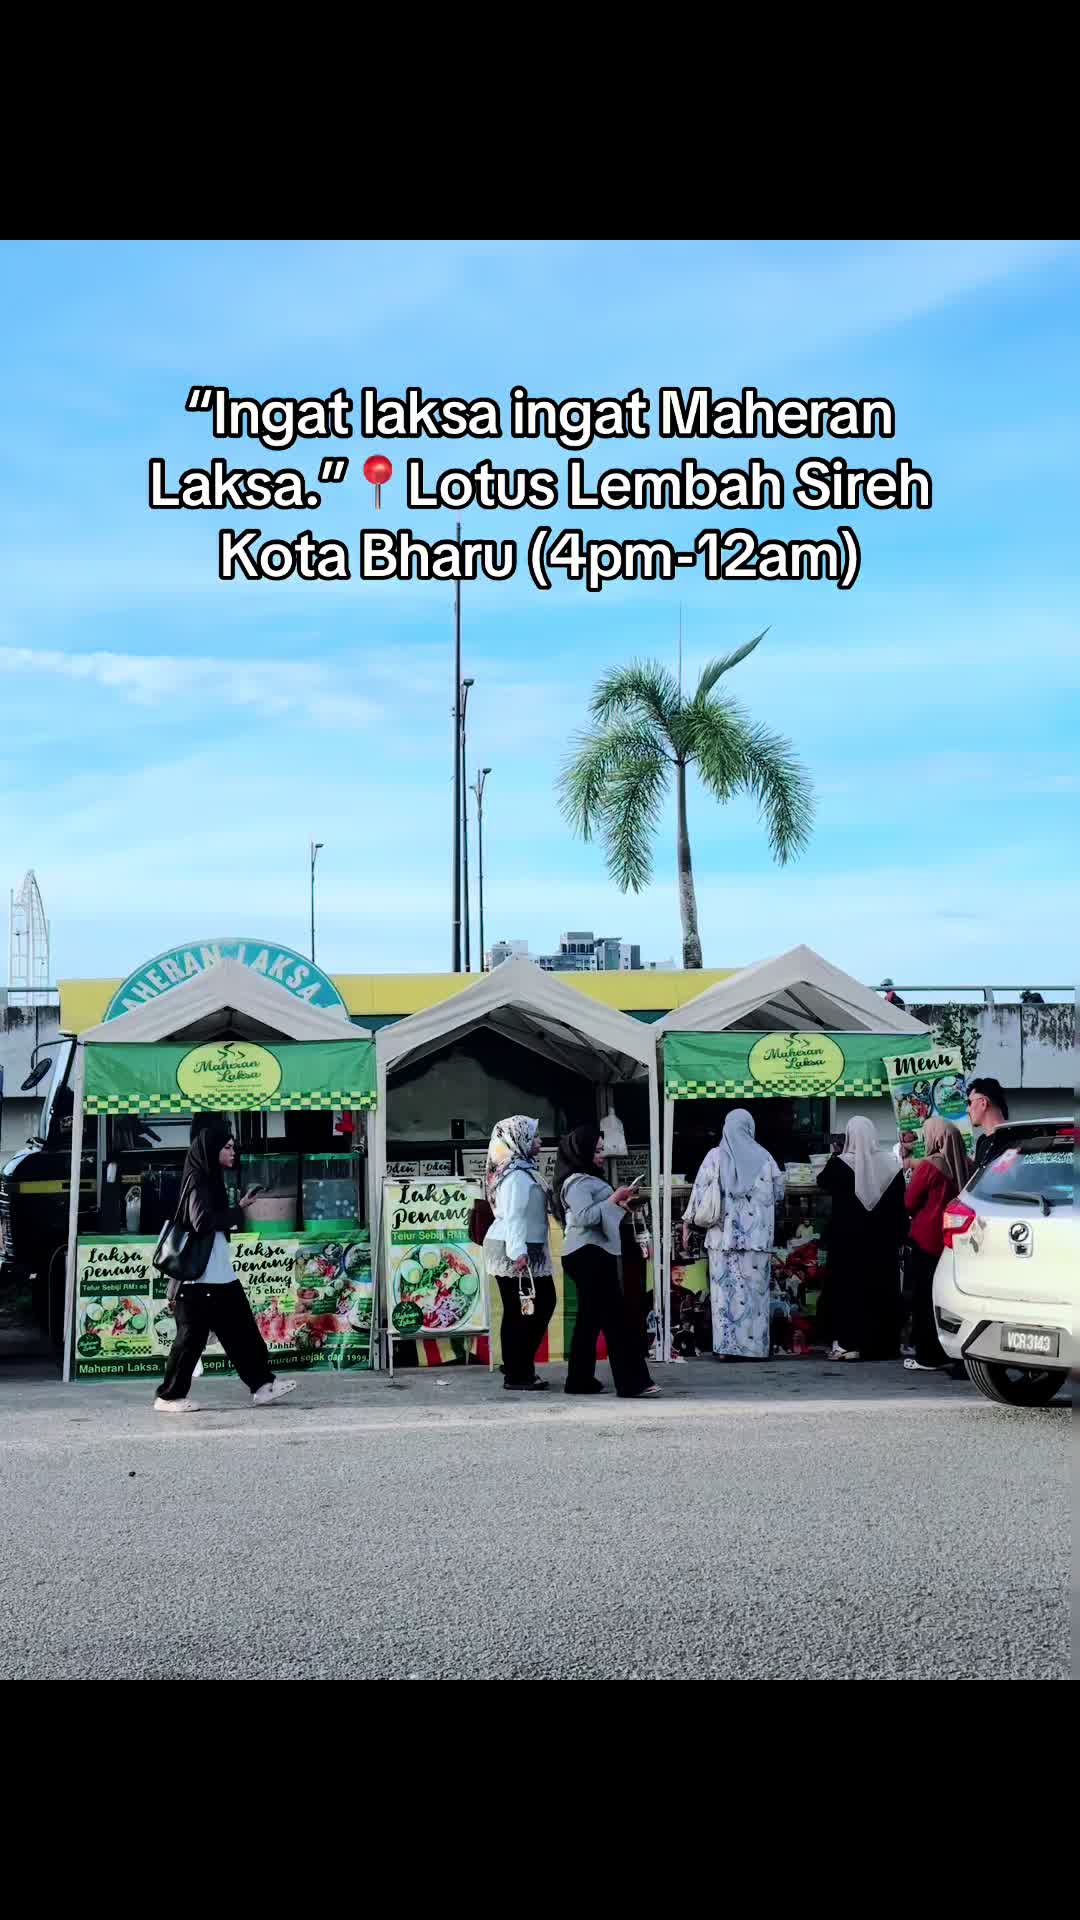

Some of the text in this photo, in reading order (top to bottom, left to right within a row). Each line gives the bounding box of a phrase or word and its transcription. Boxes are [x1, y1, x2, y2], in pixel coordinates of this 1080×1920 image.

[121, 943, 322, 1012] AHERAN LAKSA
[763, 1047, 825, 1061] Maheran
[193, 1060, 260, 1073] Maheran
[784, 1057, 826, 1069] Laksa
[893, 1054, 954, 1076] Menu
[217, 1070, 261, 1083] Laksa
[399, 1183, 468, 1205] Laksa
[391, 1207, 472, 1230] Penang
[88, 1246, 143, 1264] Laksa
[234, 1242, 286, 1259] Laksa
[81, 1264, 150, 1281] Penang
[248, 1272, 292, 1288] Udang
[255, 1285, 287, 1295] 5 ekor
[79, 1363, 124, 1374] Maheran
[127, 1361, 161, 1373] Laksa.
